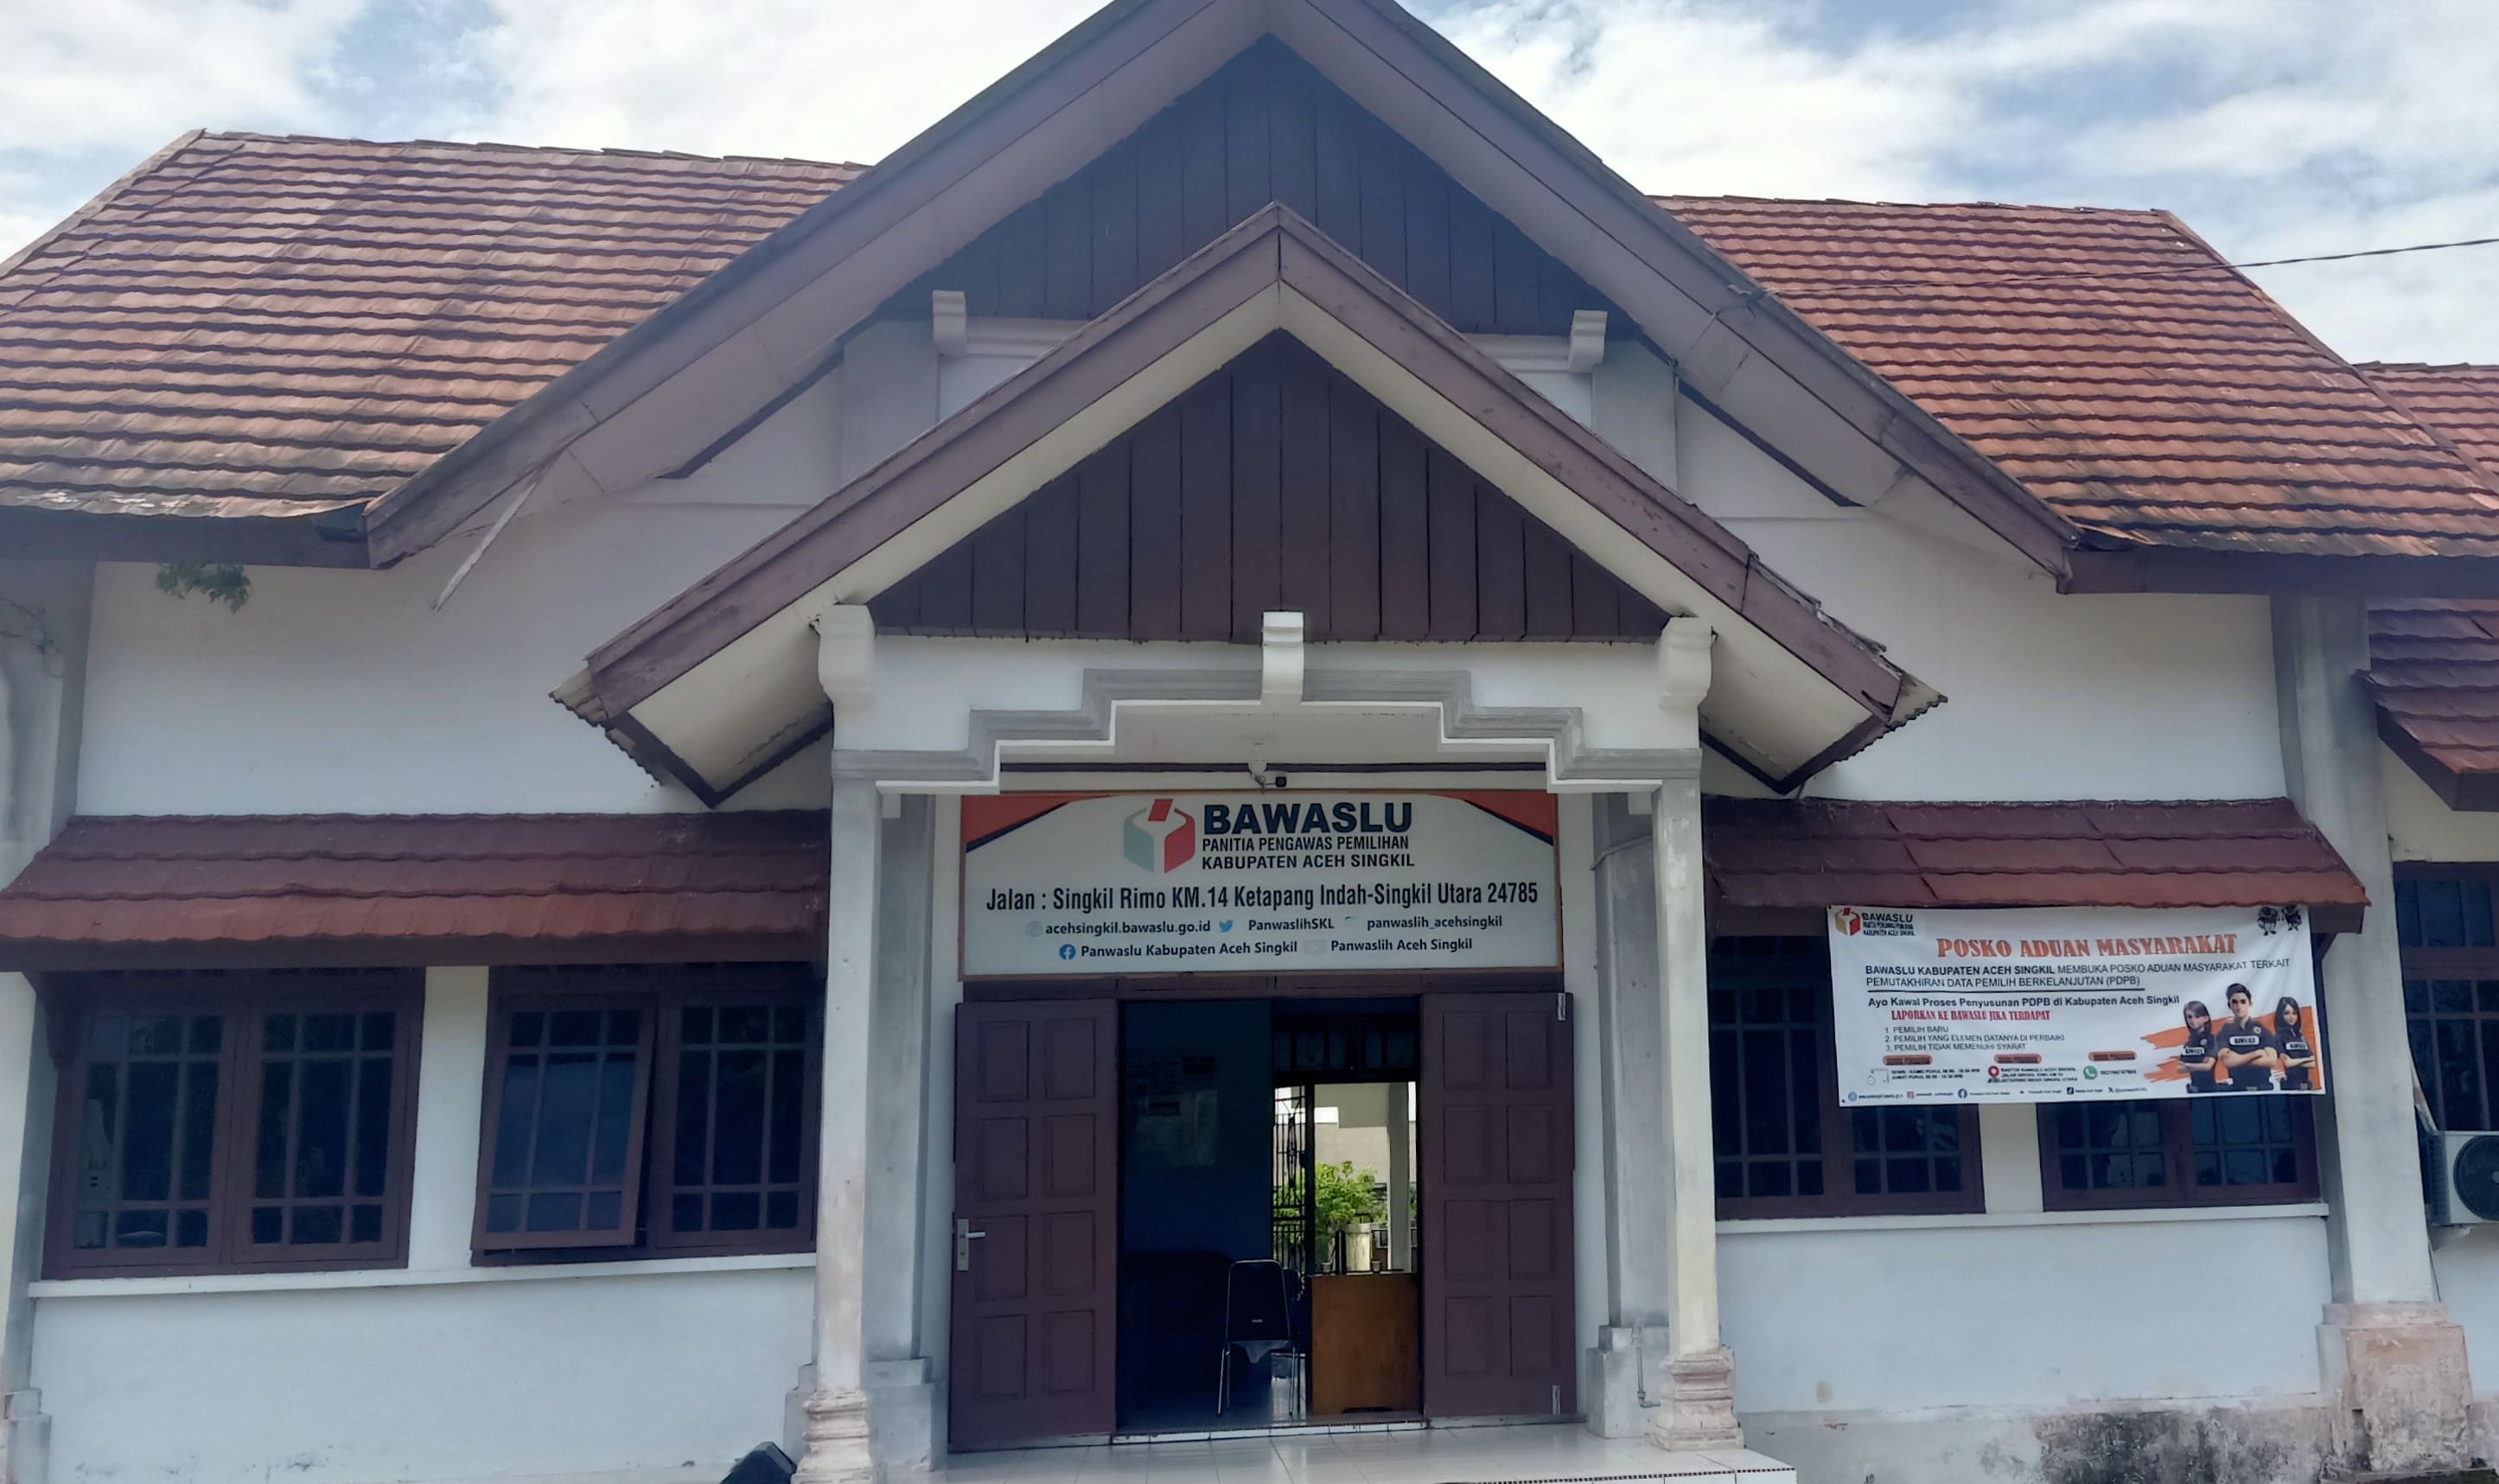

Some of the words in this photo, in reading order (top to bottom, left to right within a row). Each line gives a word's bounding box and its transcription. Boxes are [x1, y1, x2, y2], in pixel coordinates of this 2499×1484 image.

[1204, 802, 1412, 835] BAWASLU
[1202, 838, 1253, 851] PANITIA
[1259, 837, 1333, 850] PENGAWAS
[1337, 836, 1409, 850] PEMILIHAN
[1202, 855, 1297, 869] KABUPATEN
[1303, 855, 1345, 868] ACEH
[1351, 853, 1415, 867] SINGKIL
[986, 888, 1035, 910] Jalan
[1053, 887, 1113, 914] Singkil
[1120, 887, 1165, 909] Rimo
[1172, 886, 1228, 908] KM.14
[1234, 885, 1314, 911] Ketapang
[1321, 882, 1431, 908] Indah-Singkil
[1438, 882, 1482, 904] Utara
[1488, 882, 1538, 903] 24785
[1248, 918, 1335, 931] PanwaslihSKL
[1367, 915, 1502, 931] panwaslih_acehsingkil
[1862, 913, 1913, 922] BAWASLU
[1045, 920, 1210, 937] acehsingkil.bawaslu.go.id
[1081, 945, 1142, 958] Panwaslu
[1145, 943, 1215, 959] Kabupaten
[1220, 942, 1251, 954] Aceh
[1254, 941, 1297, 956] Singkil
[1331, 939, 1393, 952] Panwaslih
[1397, 939, 1427, 951] Aceh
[1431, 938, 1473, 952] Singkil
[1936, 938, 2011, 958] POSKO
[2020, 939, 2090, 958] ADUAN
[2095, 933, 2237, 957] MASYARAKAT
[1865, 965, 1915, 975] BAWASLU
[1917, 966, 1980, 976] KABUPATEN
[1982, 965, 2011, 975] ACEH
[2014, 965, 2055, 975] SINGKIL
[2057, 965, 2108, 974] MEMBUKA
[2110, 964, 2145, 973] POSKO
[2146, 963, 2182, 973] ADUAN
[2183, 961, 2247, 972] MASYARAKAT
[2251, 959, 2290, 969] TERKAIT
[1866, 978, 1945, 987] PEMUTAKHIRAN
[1948, 978, 1973, 988] DATA
[1975, 978, 2016, 987] PEMILIH
[2019, 976, 2103, 987] BERKELANJUTAN
[2107, 976, 2140, 987] (PDPB)
[1868, 997, 1888, 1009] Ayo
[1891, 997, 1920, 1006] Kawal
[1922, 997, 1957, 1007] Proses
[1960, 997, 2019, 1009] Penyusunan
[2022, 997, 2050, 1007] PDPB
[2054, 997, 2063, 1006] di
[2067, 997, 2116, 1008] Kabupaten
[2120, 997, 2143, 1005] Aceh
[2146, 996, 2179, 1006] Singkil
[1891, 1010, 1935, 1020] LAPORKAN
[1938, 1010, 1948, 1020] KE
[1951, 1010, 1987, 1020] BAWASLU
[1990, 1010, 2006, 1021] JIKA
[2009, 1010, 2050, 1020] TERDAPAT
